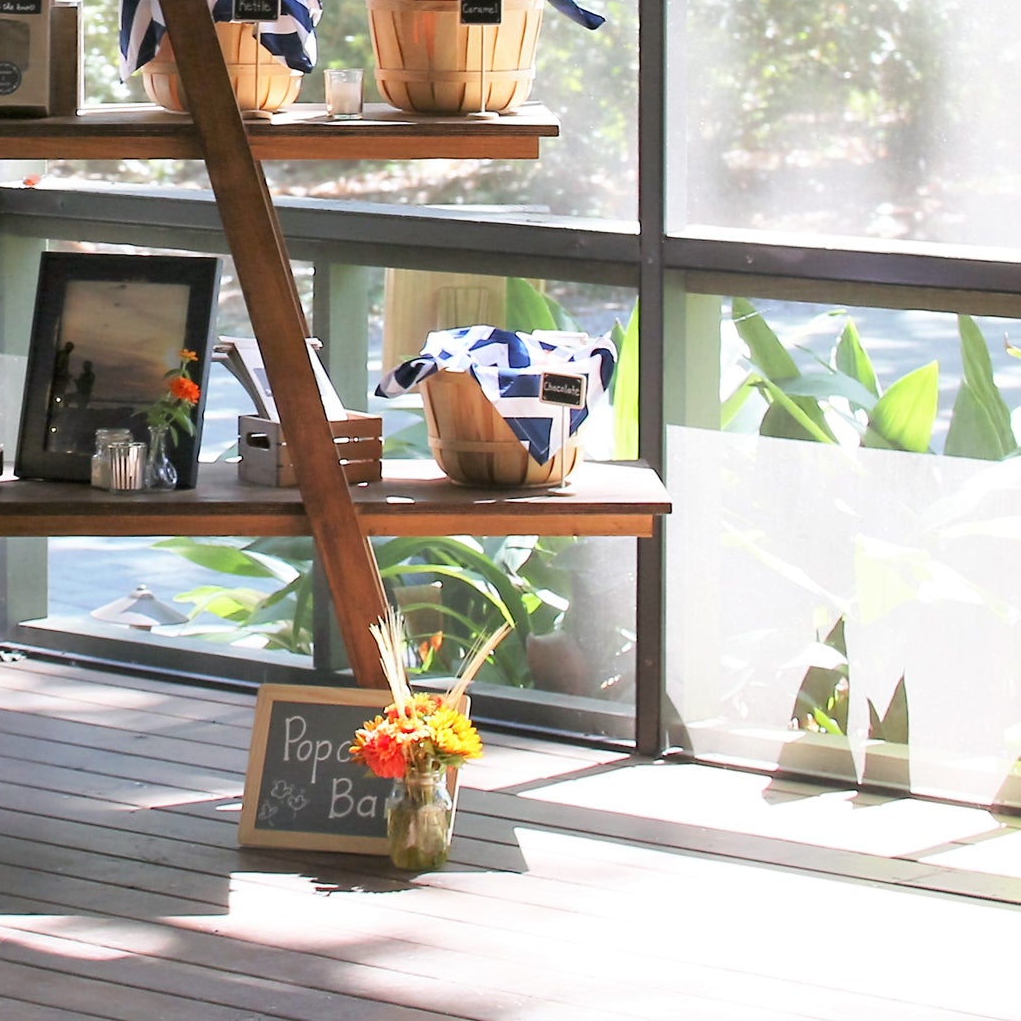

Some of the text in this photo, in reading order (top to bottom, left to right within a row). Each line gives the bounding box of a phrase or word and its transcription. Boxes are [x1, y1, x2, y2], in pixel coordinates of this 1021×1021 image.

[462, 2, 498, 14] Caramel
[544, 381, 580, 397] Chocolate
[283, 715, 352, 784] Popc
